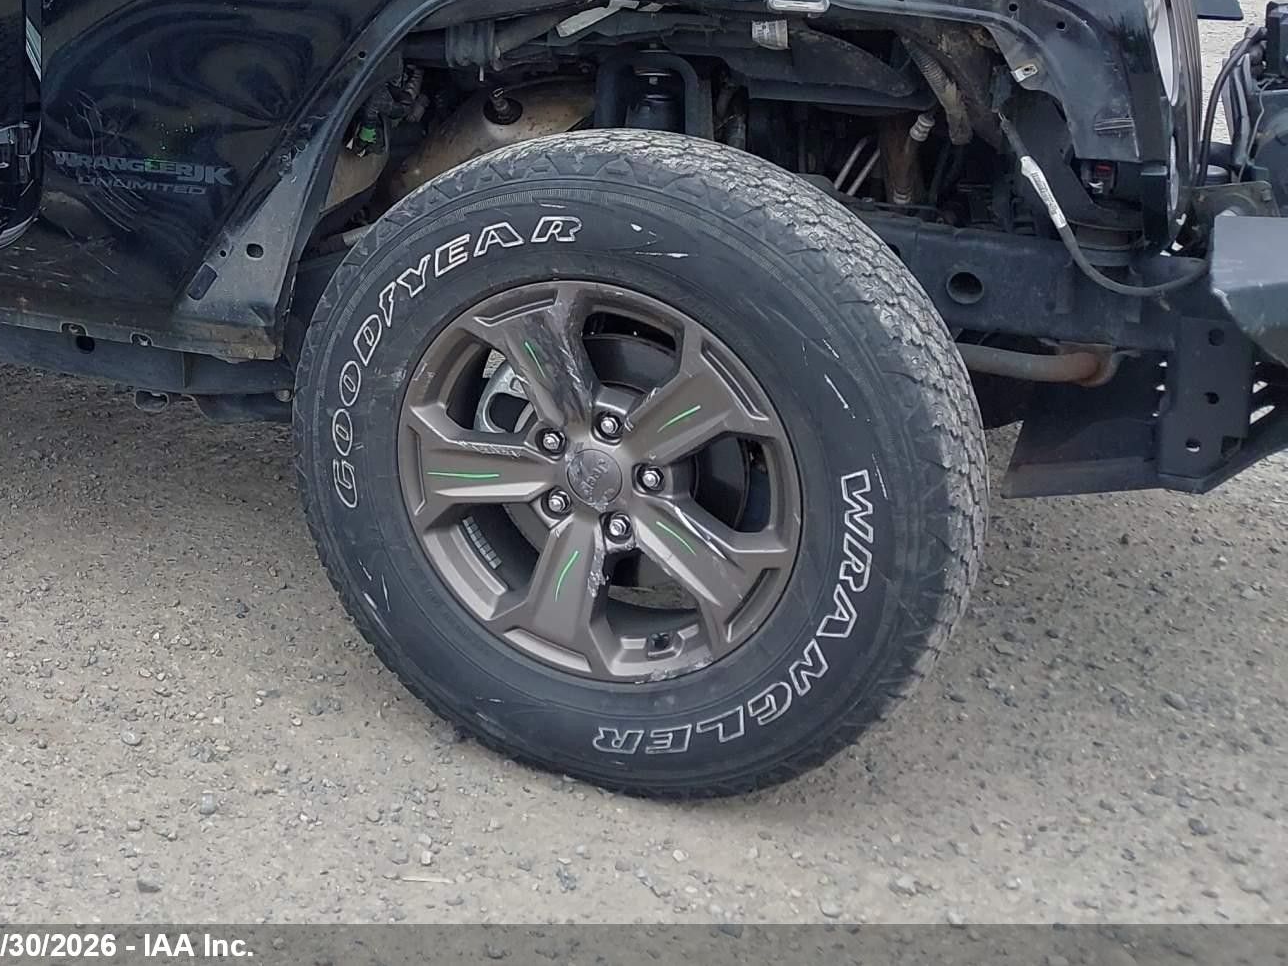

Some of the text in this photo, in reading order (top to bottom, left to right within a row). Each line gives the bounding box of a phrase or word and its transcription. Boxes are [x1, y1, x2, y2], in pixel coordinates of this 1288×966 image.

[77, 175, 208, 196] UNLIMITED
[332, 215, 583, 509] GOODYEAR
[592, 467, 889, 756] WRANGLER
